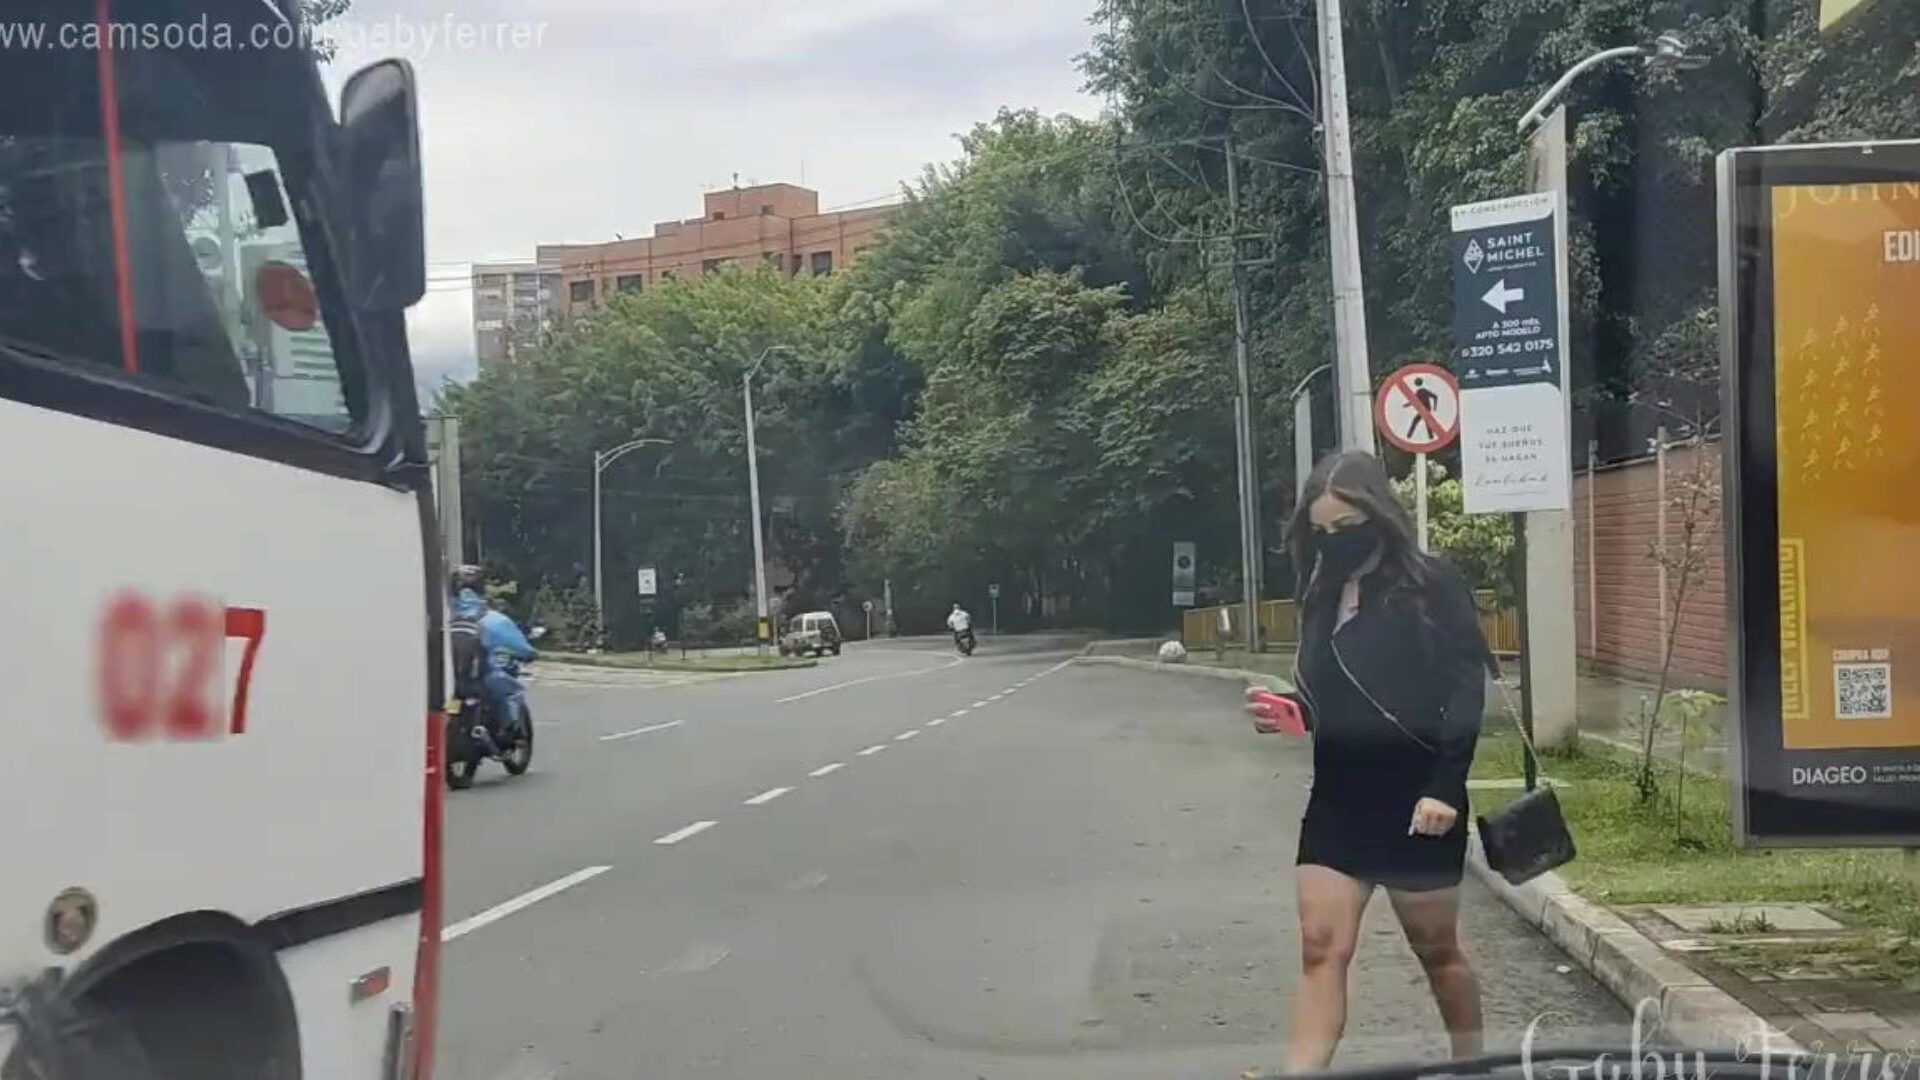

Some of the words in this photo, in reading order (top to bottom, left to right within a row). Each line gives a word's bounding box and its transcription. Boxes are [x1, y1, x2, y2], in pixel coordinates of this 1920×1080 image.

[1487, 232, 1533, 249] SAINT
[1487, 246, 1544, 263] MICHEL
[1475, 329, 1500, 340] APTO
[1501, 326, 1541, 336] MODELO
[1470, 345, 1494, 357] 320
[1496, 342, 1521, 354] 542
[1524, 338, 1554, 352] 0175
[1792, 766, 1867, 785] DIAGEO
